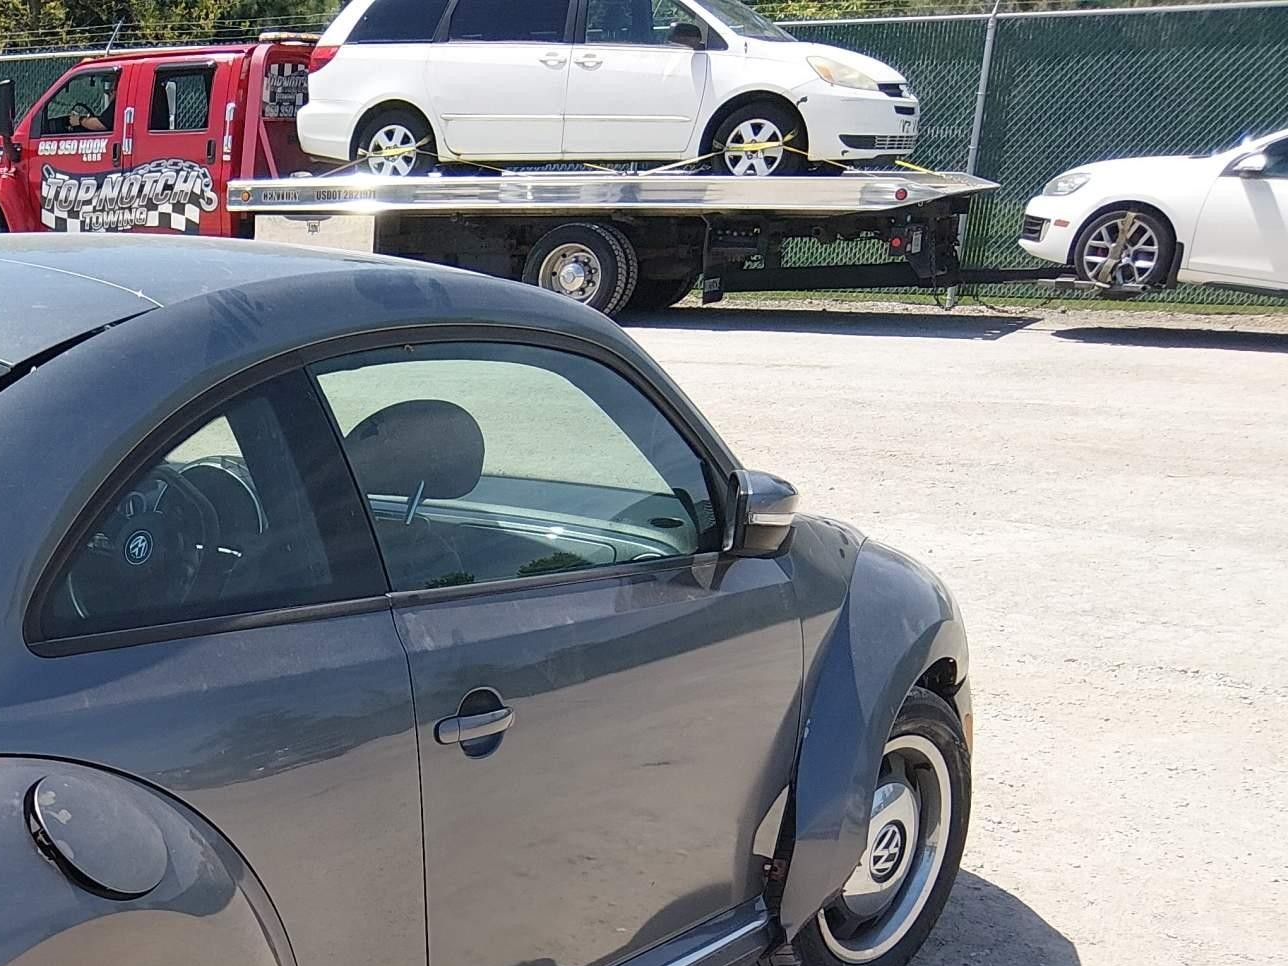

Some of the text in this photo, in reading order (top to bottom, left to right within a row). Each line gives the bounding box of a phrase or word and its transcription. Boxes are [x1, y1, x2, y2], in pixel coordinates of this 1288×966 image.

[78, 138, 109, 154] HOOK
[43, 171, 200, 212] TOP NOTCH
[262, 190, 300, 201] CENTURY
[316, 189, 342, 201] USDOT
[82, 206, 148, 231] TOWING
